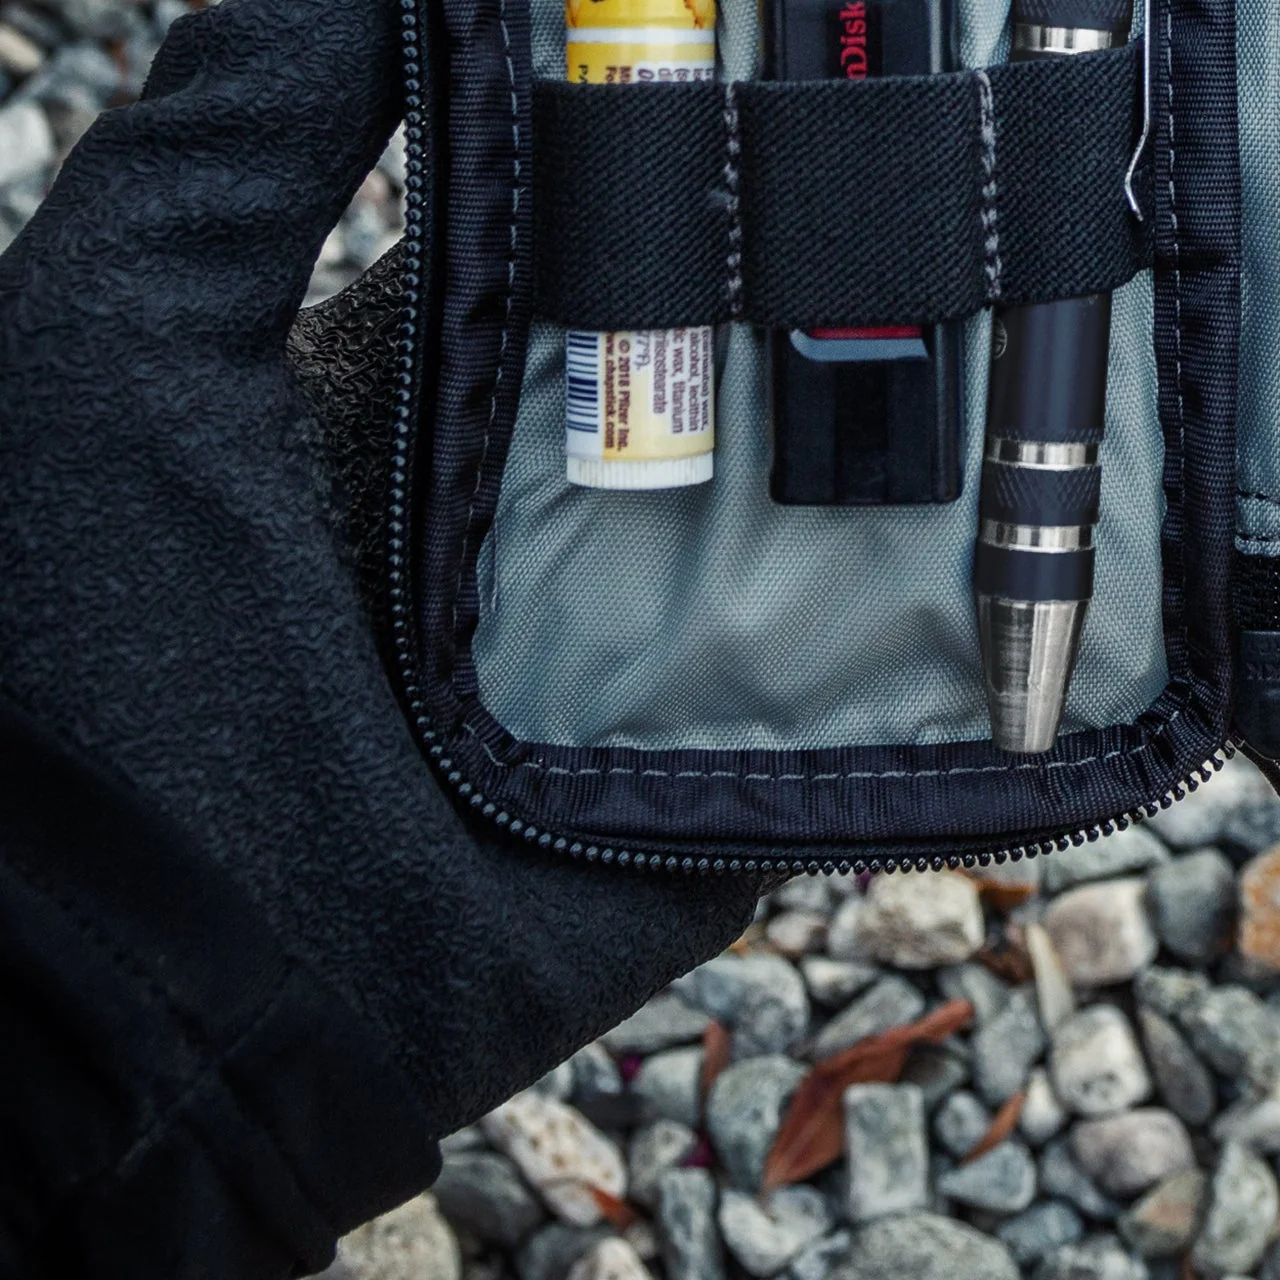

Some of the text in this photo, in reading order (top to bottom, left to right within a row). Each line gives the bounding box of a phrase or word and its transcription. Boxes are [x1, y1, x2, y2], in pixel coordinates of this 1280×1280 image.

[839, 0, 868, 79] nDisk
[671, 346, 684, 378] wax,
[618, 391, 630, 425] Pfizer
[673, 381, 685, 434] titanium
[689, 385, 700, 432] lecithin
[617, 428, 631, 452] Inc.
